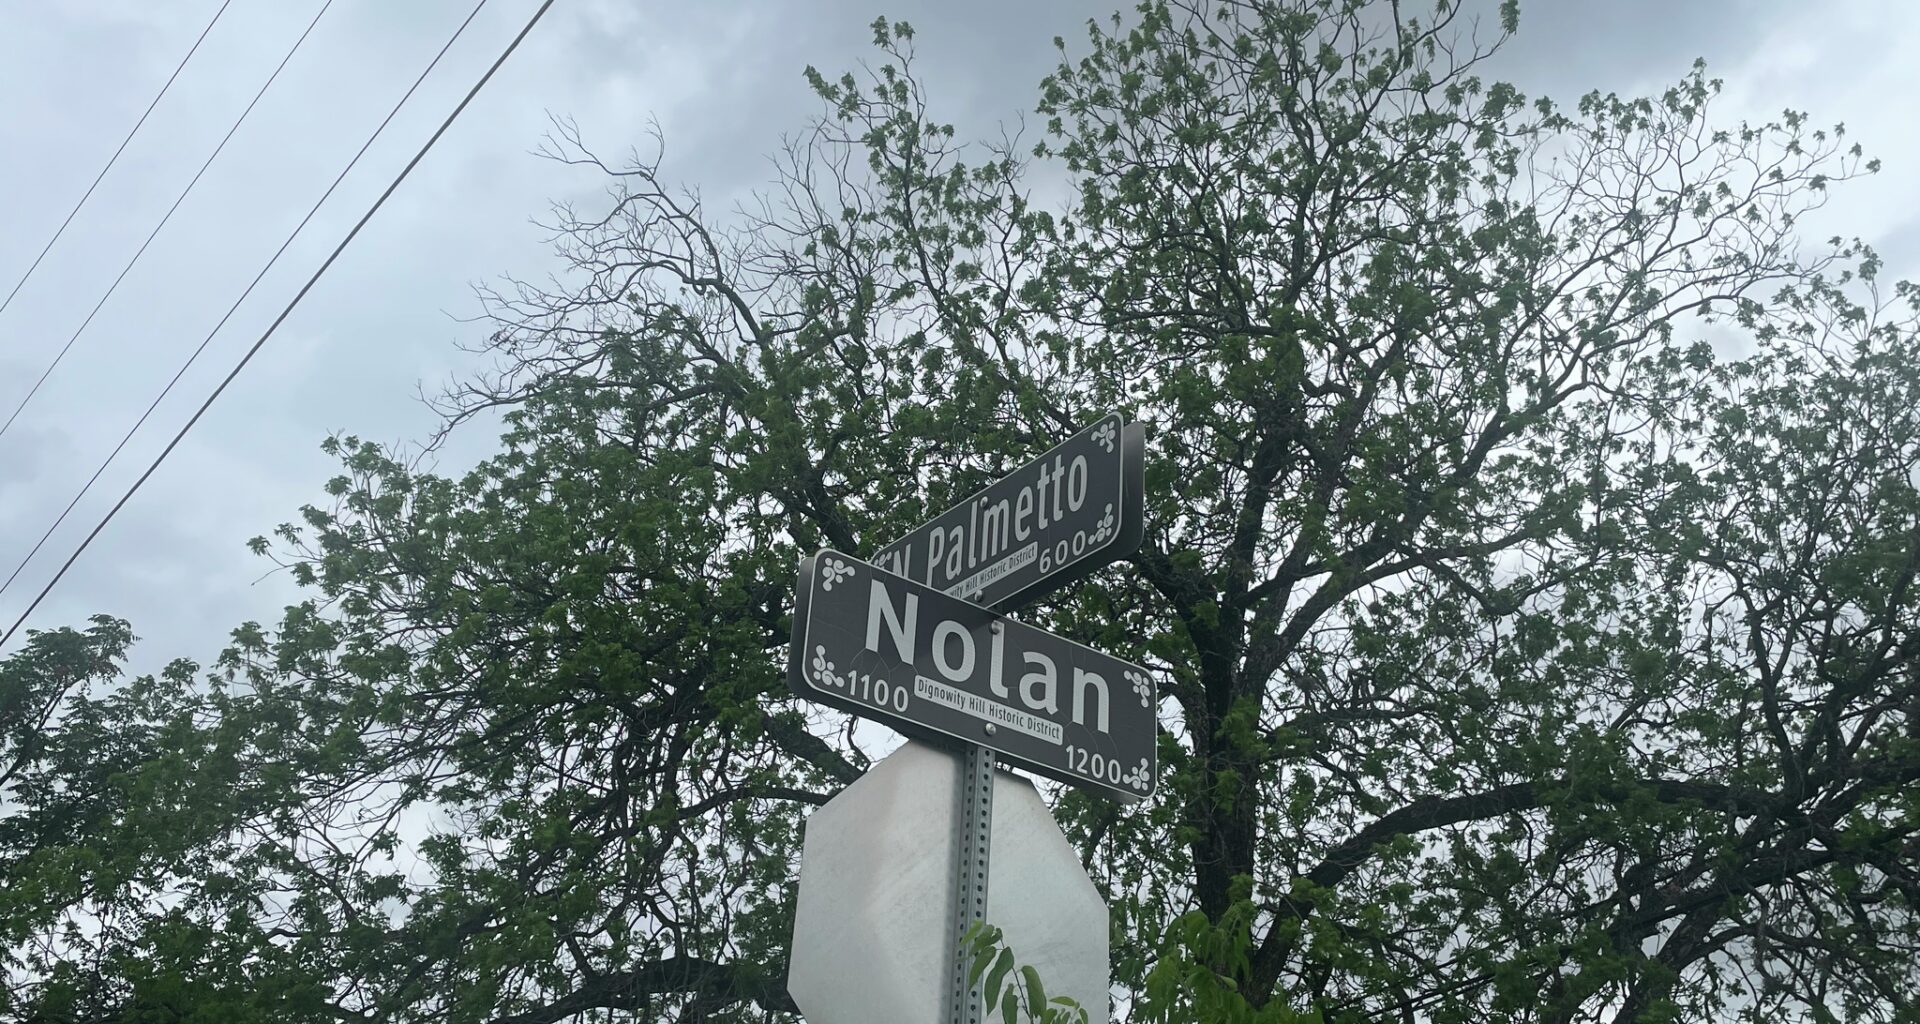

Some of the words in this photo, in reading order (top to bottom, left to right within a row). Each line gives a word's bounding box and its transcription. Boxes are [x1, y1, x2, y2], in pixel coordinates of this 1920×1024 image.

[926, 455, 1088, 589] Palmetto
[965, 572, 978, 589] Hill
[980, 562, 1007, 584] Historic
[1009, 546, 1036, 569] District
[1039, 530, 1086, 574] 600
[865, 578, 1110, 734] Nolan
[848, 670, 909, 712] 1100
[918, 679, 967, 710] Dignowity
[968, 696, 985, 715] Hill
[989, 703, 1024, 728] Historic
[1027, 717, 1060, 740] District
[1066, 744, 1121, 785] 1200
